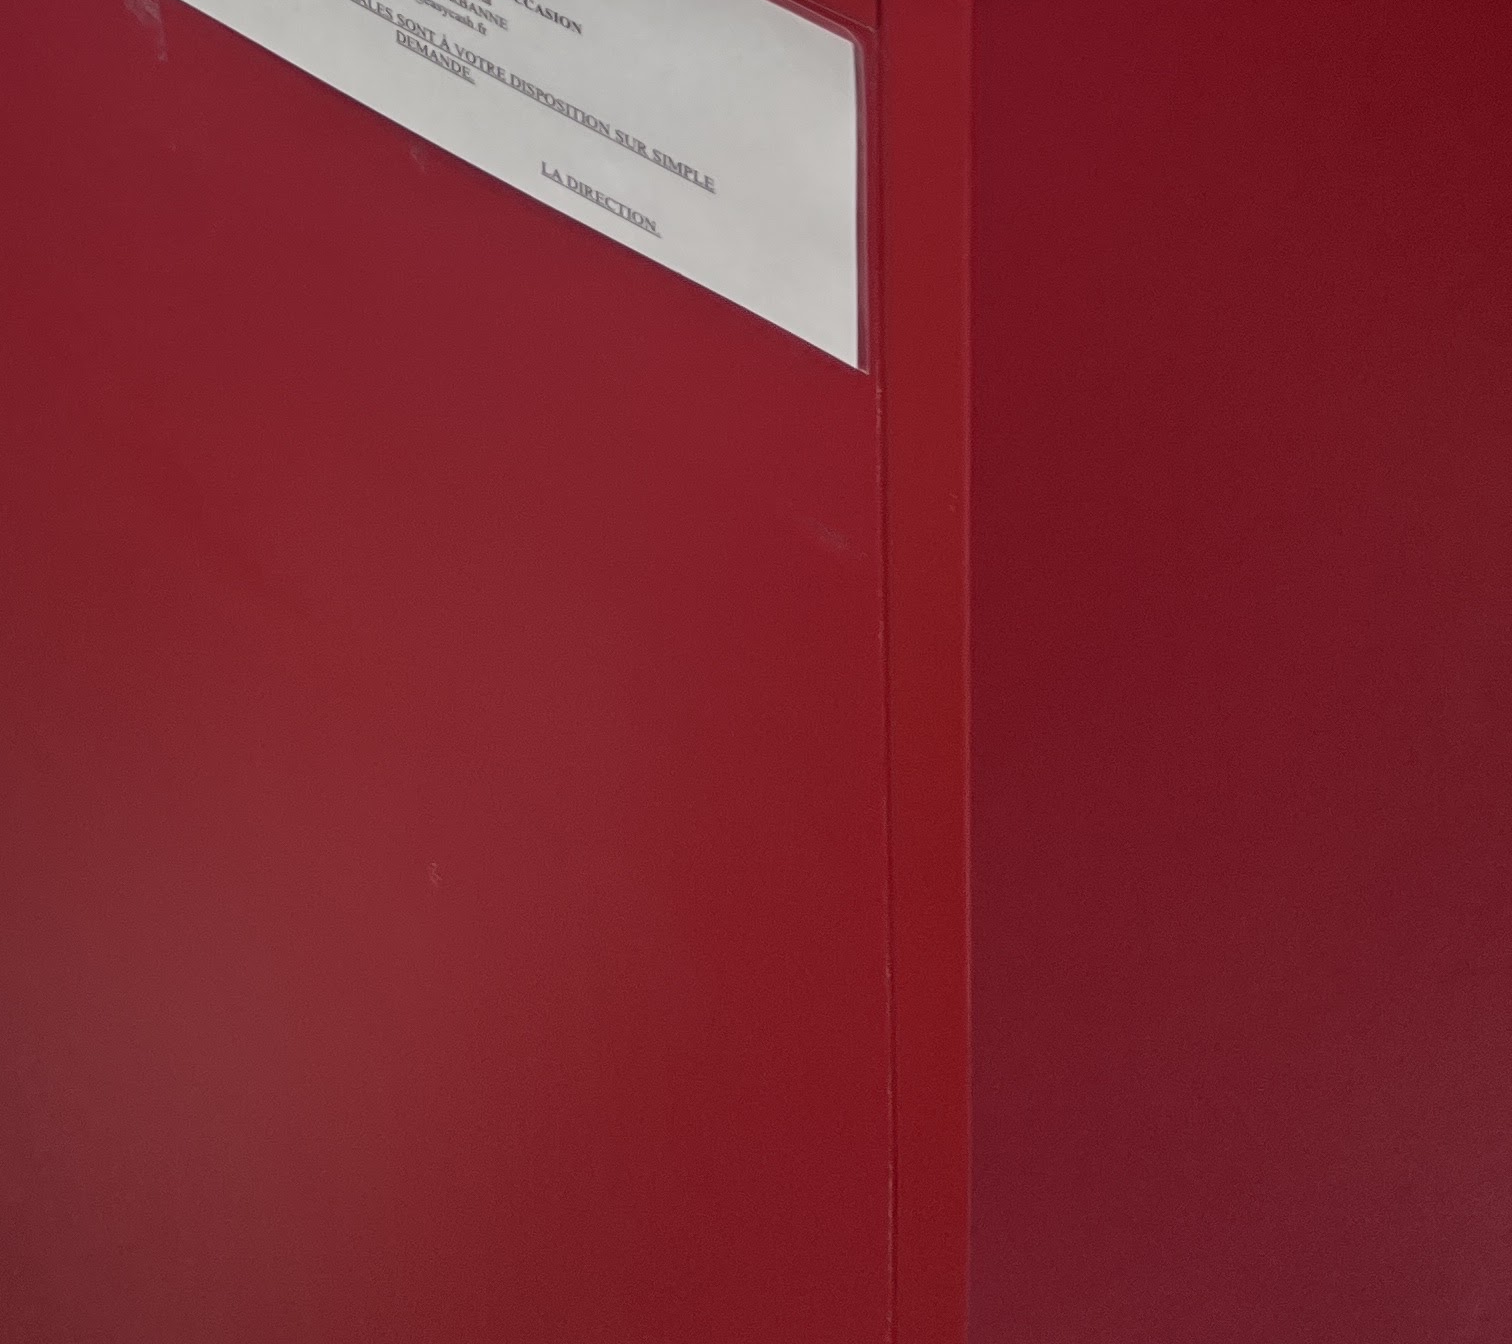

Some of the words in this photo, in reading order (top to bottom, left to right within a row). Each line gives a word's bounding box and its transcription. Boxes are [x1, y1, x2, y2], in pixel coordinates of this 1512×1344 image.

[396, 12, 437, 45] SONT
[440, 33, 452, 53] À
[454, 43, 506, 83] VOTRE
[509, 73, 612, 138] DISPOSITION
[614, 128, 648, 160] SUR
[652, 148, 717, 195] SIMPLE
[541, 161, 565, 185] LA
